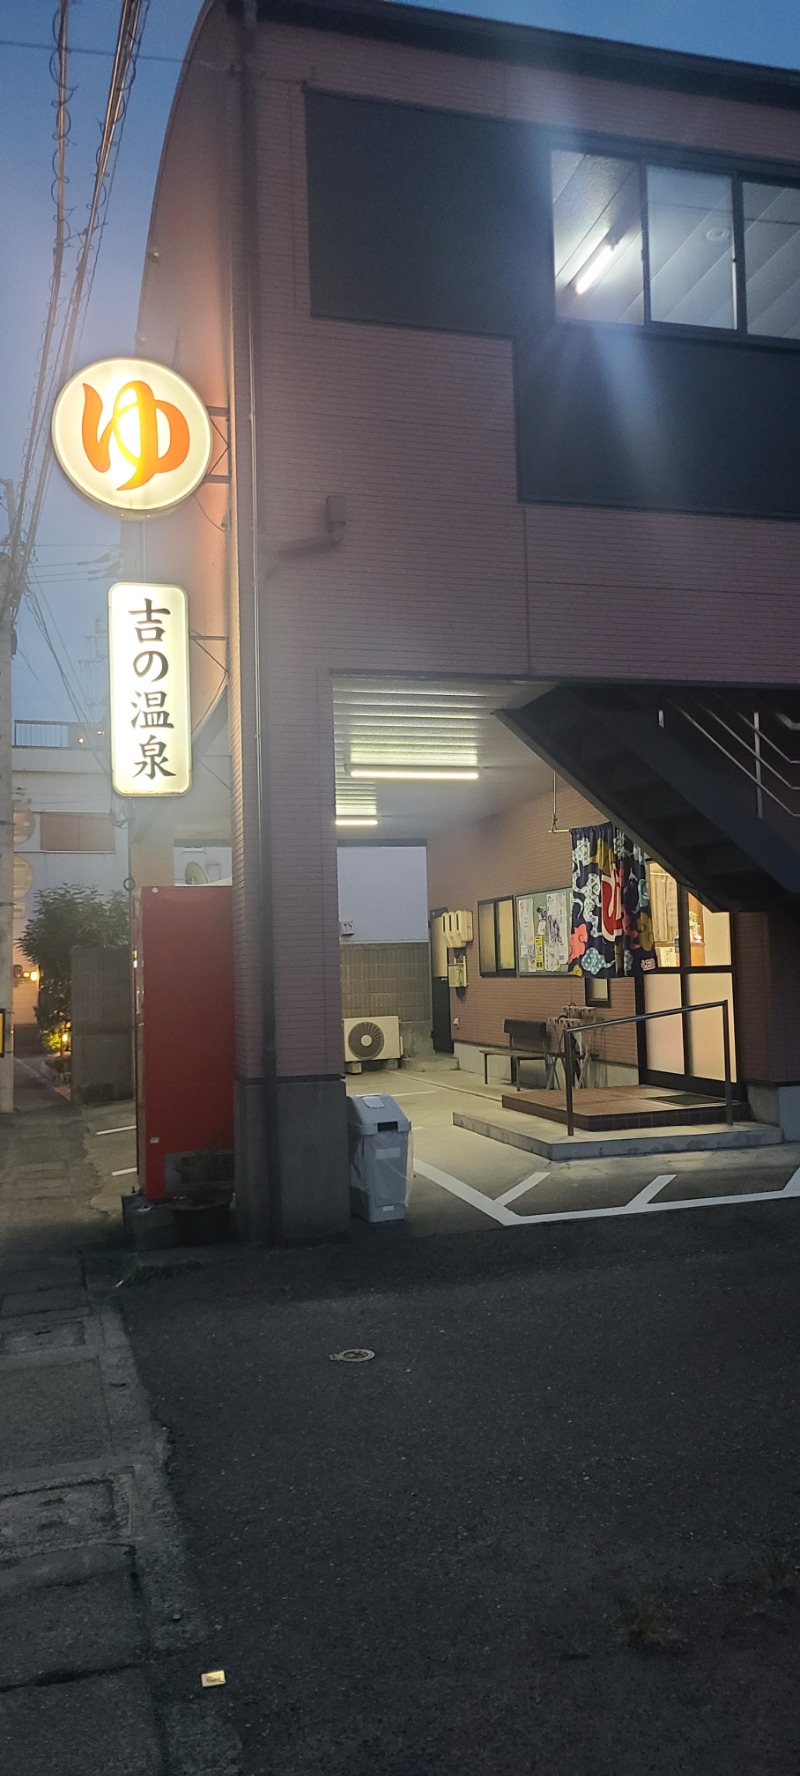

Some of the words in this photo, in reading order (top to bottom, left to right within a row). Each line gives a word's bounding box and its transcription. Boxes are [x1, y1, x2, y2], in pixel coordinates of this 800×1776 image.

[82, 380, 190, 492] ゆ
[128, 597, 177, 780] 吉の温泉
